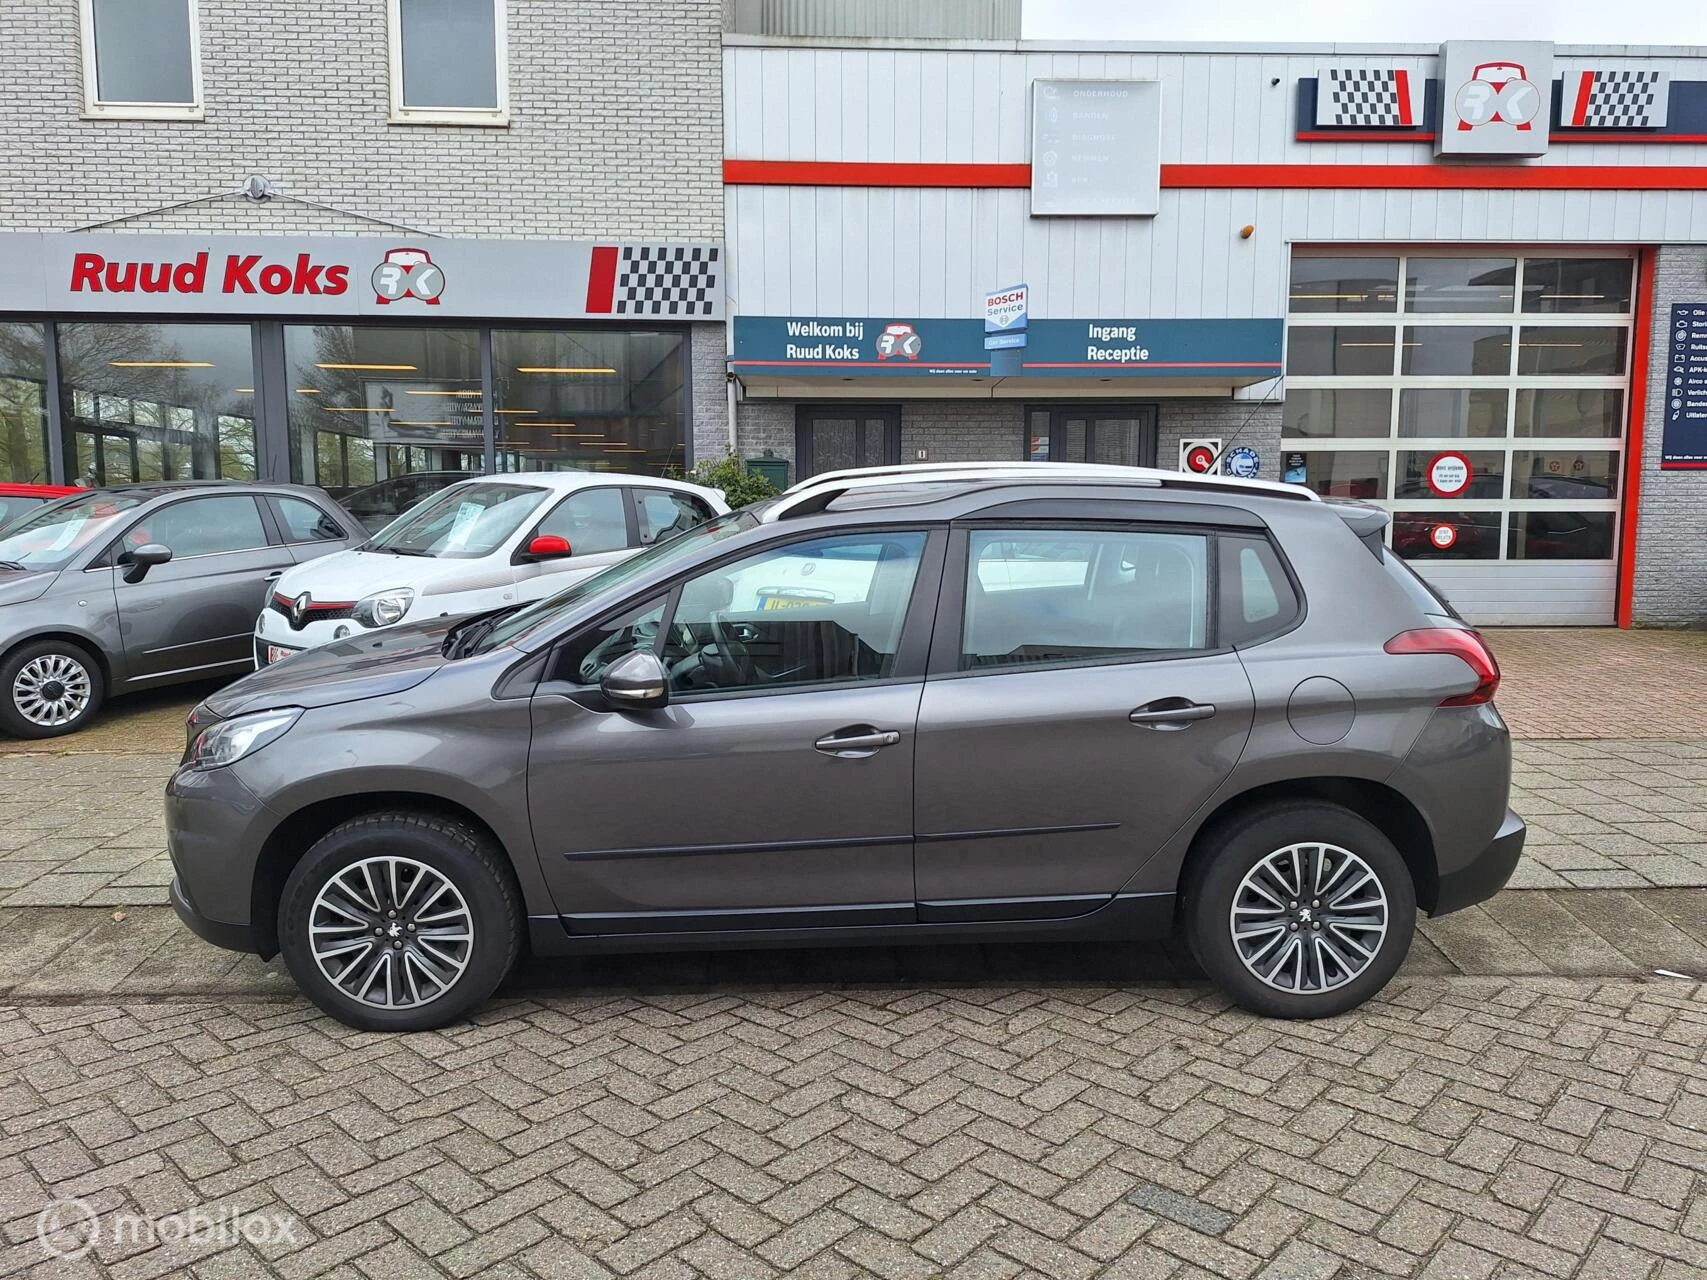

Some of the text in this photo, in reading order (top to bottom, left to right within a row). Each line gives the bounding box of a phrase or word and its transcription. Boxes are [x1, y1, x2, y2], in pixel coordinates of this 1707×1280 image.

[1073, 89, 1129, 98] ONDERHOUD
[70, 251, 350, 296] Ruud Koks
[987, 291, 1024, 307] BOSCH
[987, 303, 1024, 316] Service
[786, 321, 864, 341] Welkom bij
[1088, 323, 1137, 341] Ingang
[1691, 320, 1707, 328] Stori
[786, 344, 860, 360] Ruud Koks
[1087, 345, 1150, 363] Receptie
